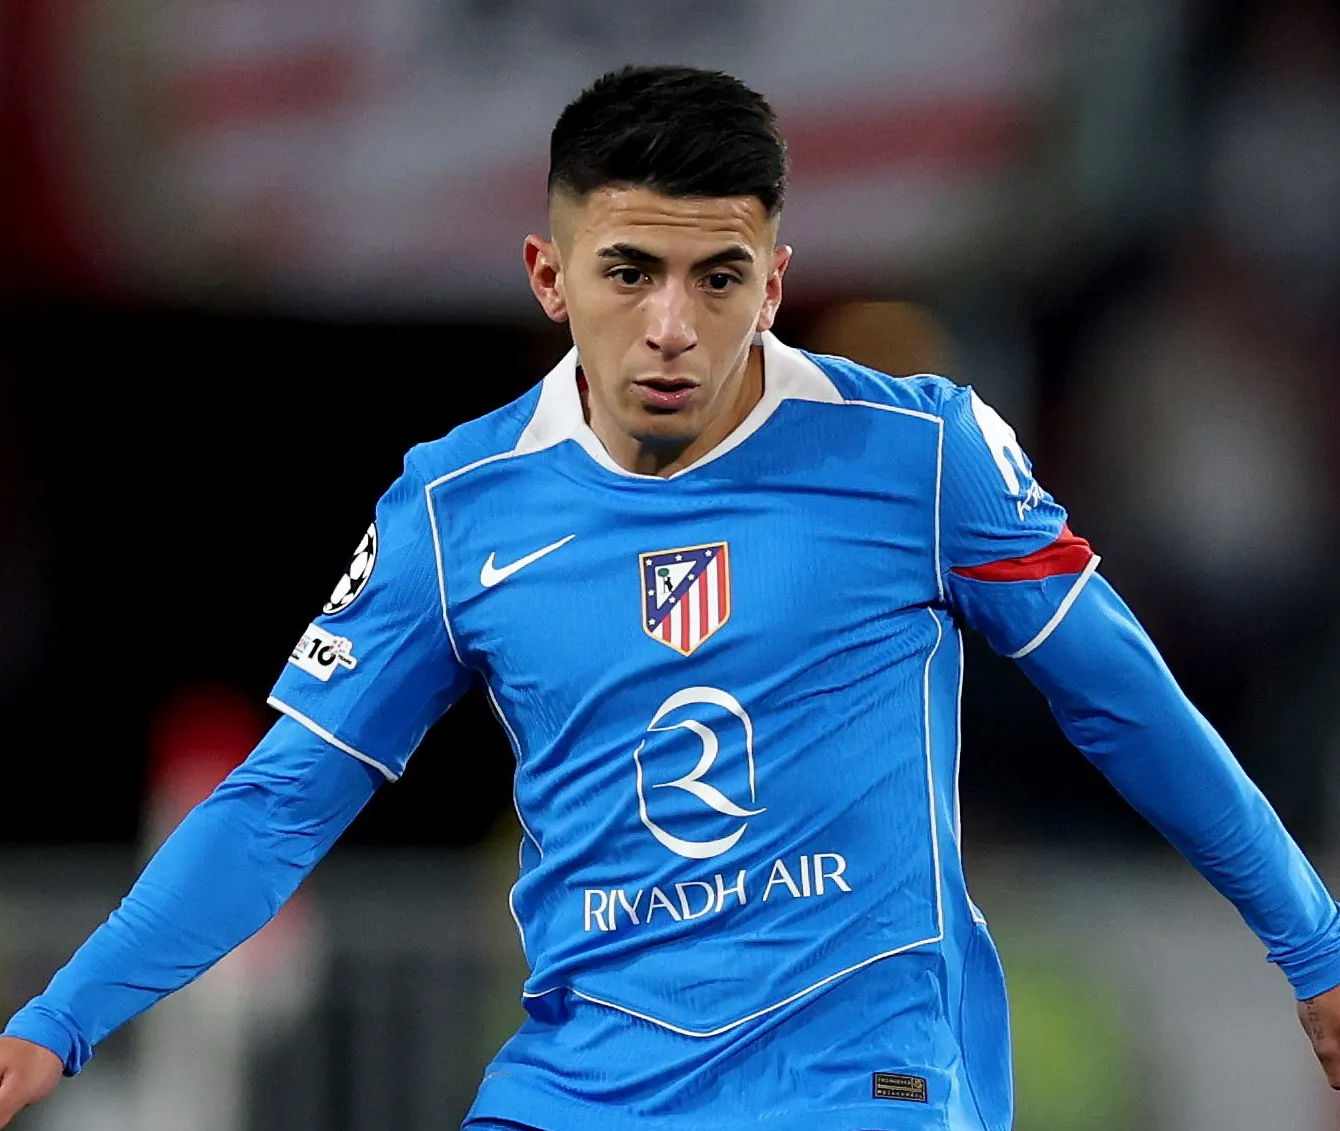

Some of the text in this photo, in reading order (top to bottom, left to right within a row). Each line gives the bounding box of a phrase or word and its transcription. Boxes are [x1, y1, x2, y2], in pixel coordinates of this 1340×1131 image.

[308, 638, 336, 667] 10
[583, 852, 852, 932] RIYADH AIR
